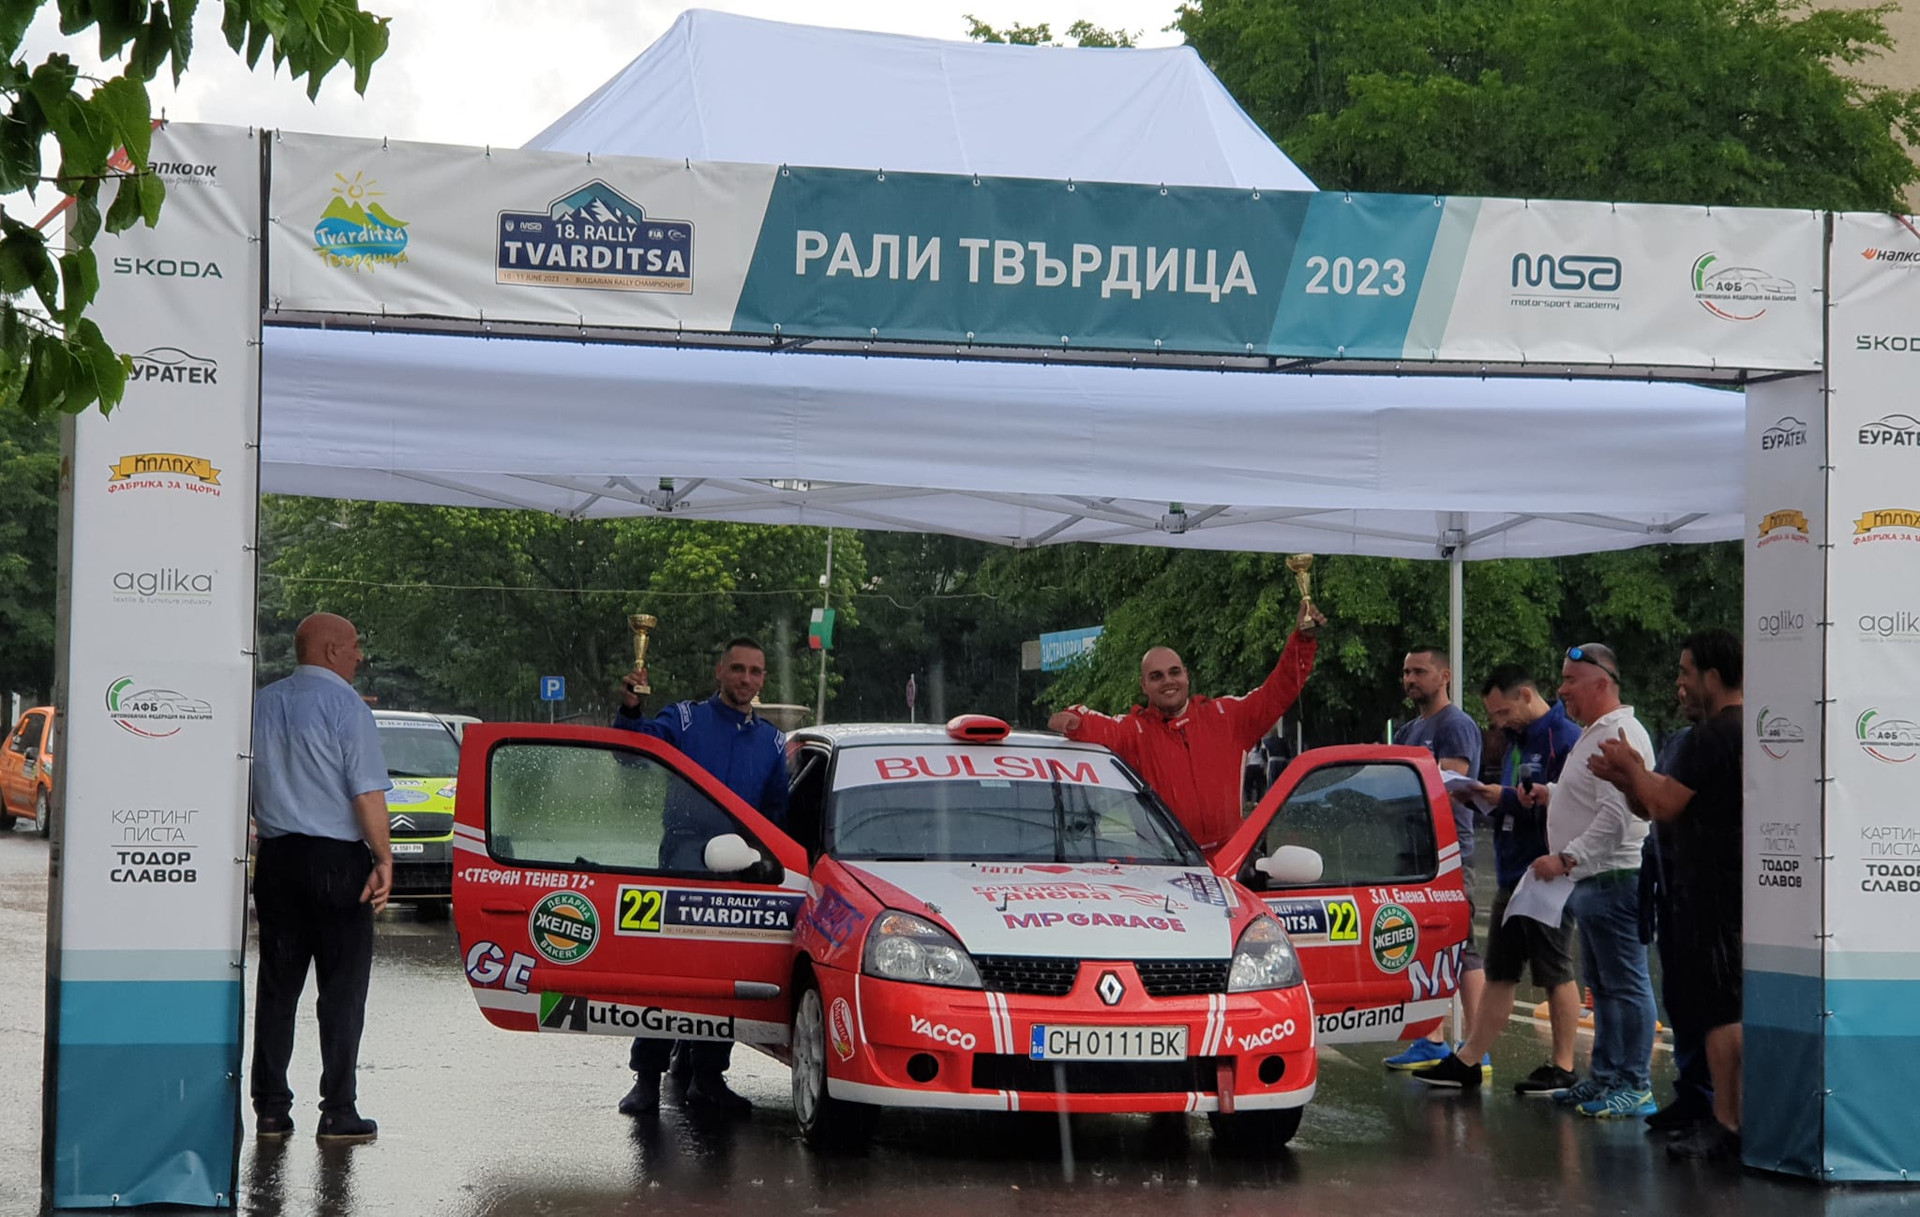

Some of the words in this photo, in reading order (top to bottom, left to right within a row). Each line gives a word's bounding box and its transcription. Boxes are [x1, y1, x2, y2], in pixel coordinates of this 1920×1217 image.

[148, 161, 217, 177] ankook
[316, 223, 405, 245] Tvarditsa
[555, 224, 580, 240] 18.
[584, 225, 637, 242] RALLY
[504, 241, 686, 273] TVARDITSA
[1877, 250, 1920, 262] Hanko
[795, 230, 941, 281] РАЛИ
[958, 237, 1257, 302] ТВЪРДИЦА
[1305, 256, 1407, 296] 2023
[525, 274, 542, 282] JUNE
[575, 278, 613, 286] BULGARIAN
[614, 279, 633, 287] RALLY
[634, 281, 685, 289] CHAMPIONSHIP
[1716, 282, 1742, 292] АФБ
[1511, 299, 1571, 308] motorsport
[1573, 301, 1620, 310] academy
[127, 364, 217, 384] УРАТЕК
[1762, 430, 1807, 450] ЕУРАТЕК
[1859, 430, 1920, 446] ЕУРАТ
[108, 480, 163, 494] ФАБРИКА
[167, 480, 181, 489] ЗА
[186, 482, 221, 497] ЩОРИ
[113, 568, 212, 596] aglika
[1859, 611, 1920, 637] aglik
[547, 679, 560, 697] P
[132, 702, 158, 712] АФБ
[1877, 731, 1898, 740] АФБ
[875, 755, 1100, 784] BULSIM
[112, 809, 199, 824] КАРТИНГ
[124, 827, 186, 842] ПИСТА
[1861, 826, 1920, 840] КАРТИН
[117, 851, 191, 865] ТОДОР
[1762, 859, 1799, 872] ТОДОР
[110, 869, 197, 883] СЛАВОВ
[525, 871, 569, 888] ТЕНЕВ
[1759, 875, 1802, 888] СЛАВОВ
[1861, 880, 1920, 892] СЛАВО
[710, 896, 725, 906] 18.
[728, 897, 760, 908] RALLY
[1392, 888, 1427, 903] Елена
[1424, 887, 1466, 903] Тенева
[547, 896, 591, 919] ПЕКАРНА
[621, 889, 661, 930] 22
[678, 906, 789, 926] TVARDITSA
[536, 913, 593, 941] ЖЕЛЕВ
[1278, 915, 1318, 931] DITSA
[1327, 902, 1358, 940] 22
[1375, 927, 1414, 949] ЖЕЛЕВ
[539, 940, 578, 958] BAKERY
[1382, 953, 1409, 968] BAKERY
[1317, 1004, 1404, 1034] toGrand
[910, 1015, 976, 1050] YACCO
[1238, 1019, 1296, 1051] YACCO
